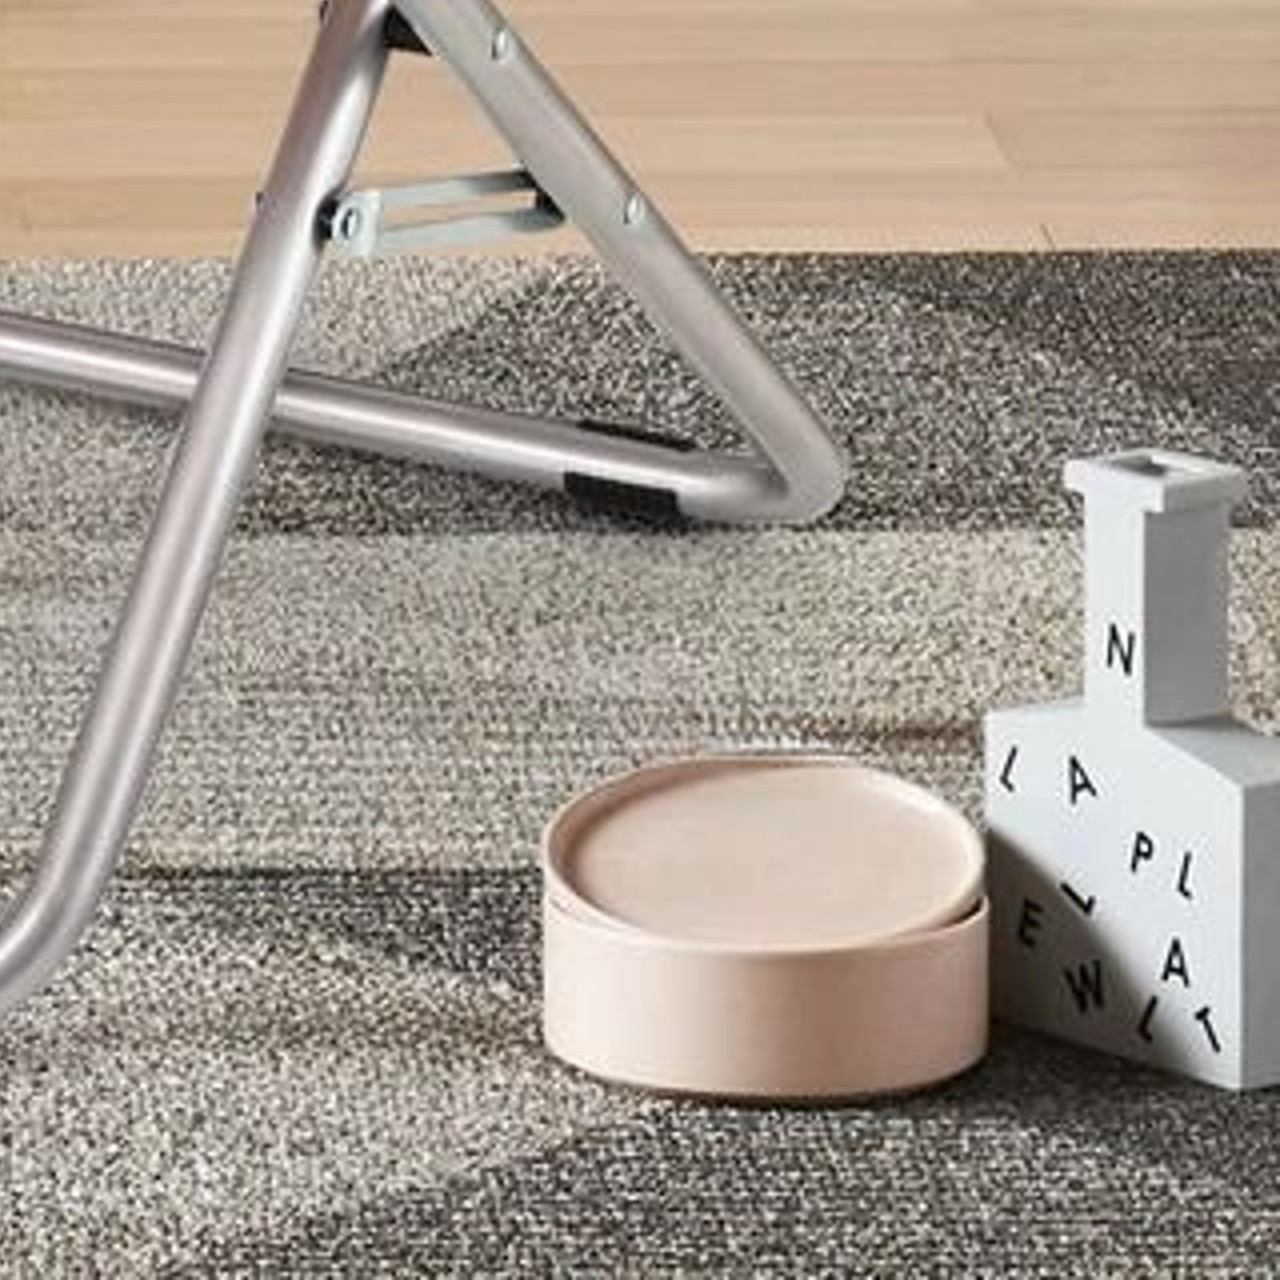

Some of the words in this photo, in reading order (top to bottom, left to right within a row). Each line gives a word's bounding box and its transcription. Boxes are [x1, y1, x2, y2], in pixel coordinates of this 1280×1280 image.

[1106, 623, 1138, 676] N
[999, 746, 1018, 793] L
[1068, 755, 1098, 805] A
[1131, 831, 1155, 873] P
[1177, 851, 1193, 899] L
[1018, 902, 1041, 946] E
[1064, 960, 1106, 1013] W
[1161, 937, 1190, 988] A
[1139, 994, 1159, 1043] L
[1195, 1005, 1221, 1054] T
